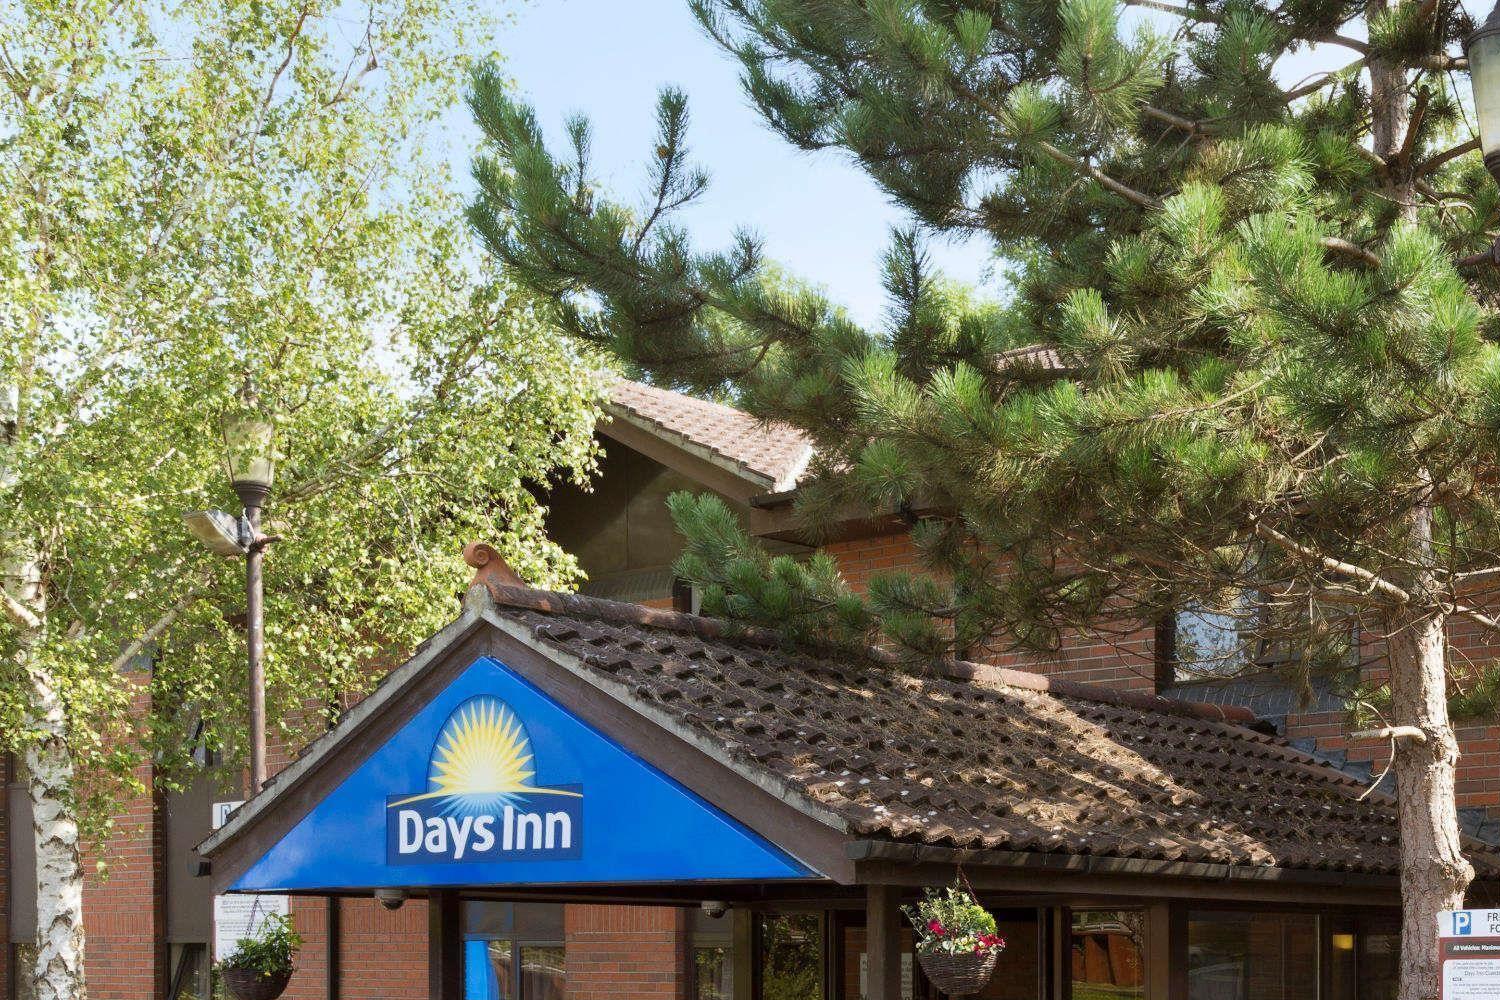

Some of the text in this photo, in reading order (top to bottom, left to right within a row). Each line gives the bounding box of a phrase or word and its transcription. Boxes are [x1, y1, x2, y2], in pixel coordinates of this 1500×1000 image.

[399, 805, 572, 860] Days Inn
[1455, 912, 1469, 935] P
